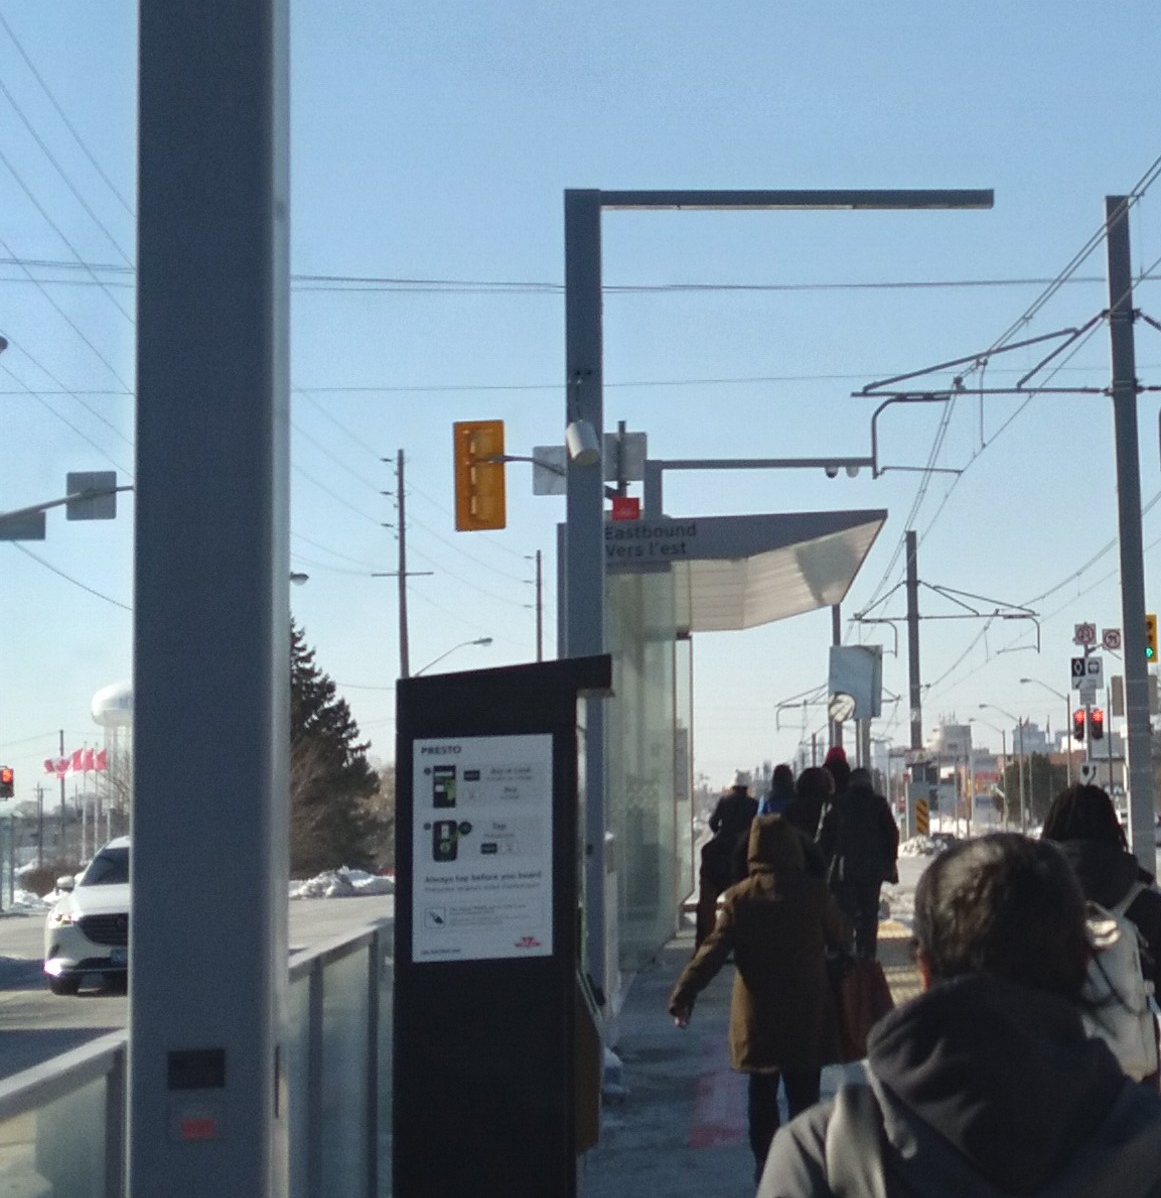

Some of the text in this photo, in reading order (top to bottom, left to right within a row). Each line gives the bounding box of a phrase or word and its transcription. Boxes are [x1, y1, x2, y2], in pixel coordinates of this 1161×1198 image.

[605, 521, 697, 540] Eastbound
[605, 541, 687, 558] Vers l'est
[421, 745, 462, 755] PRESTO
